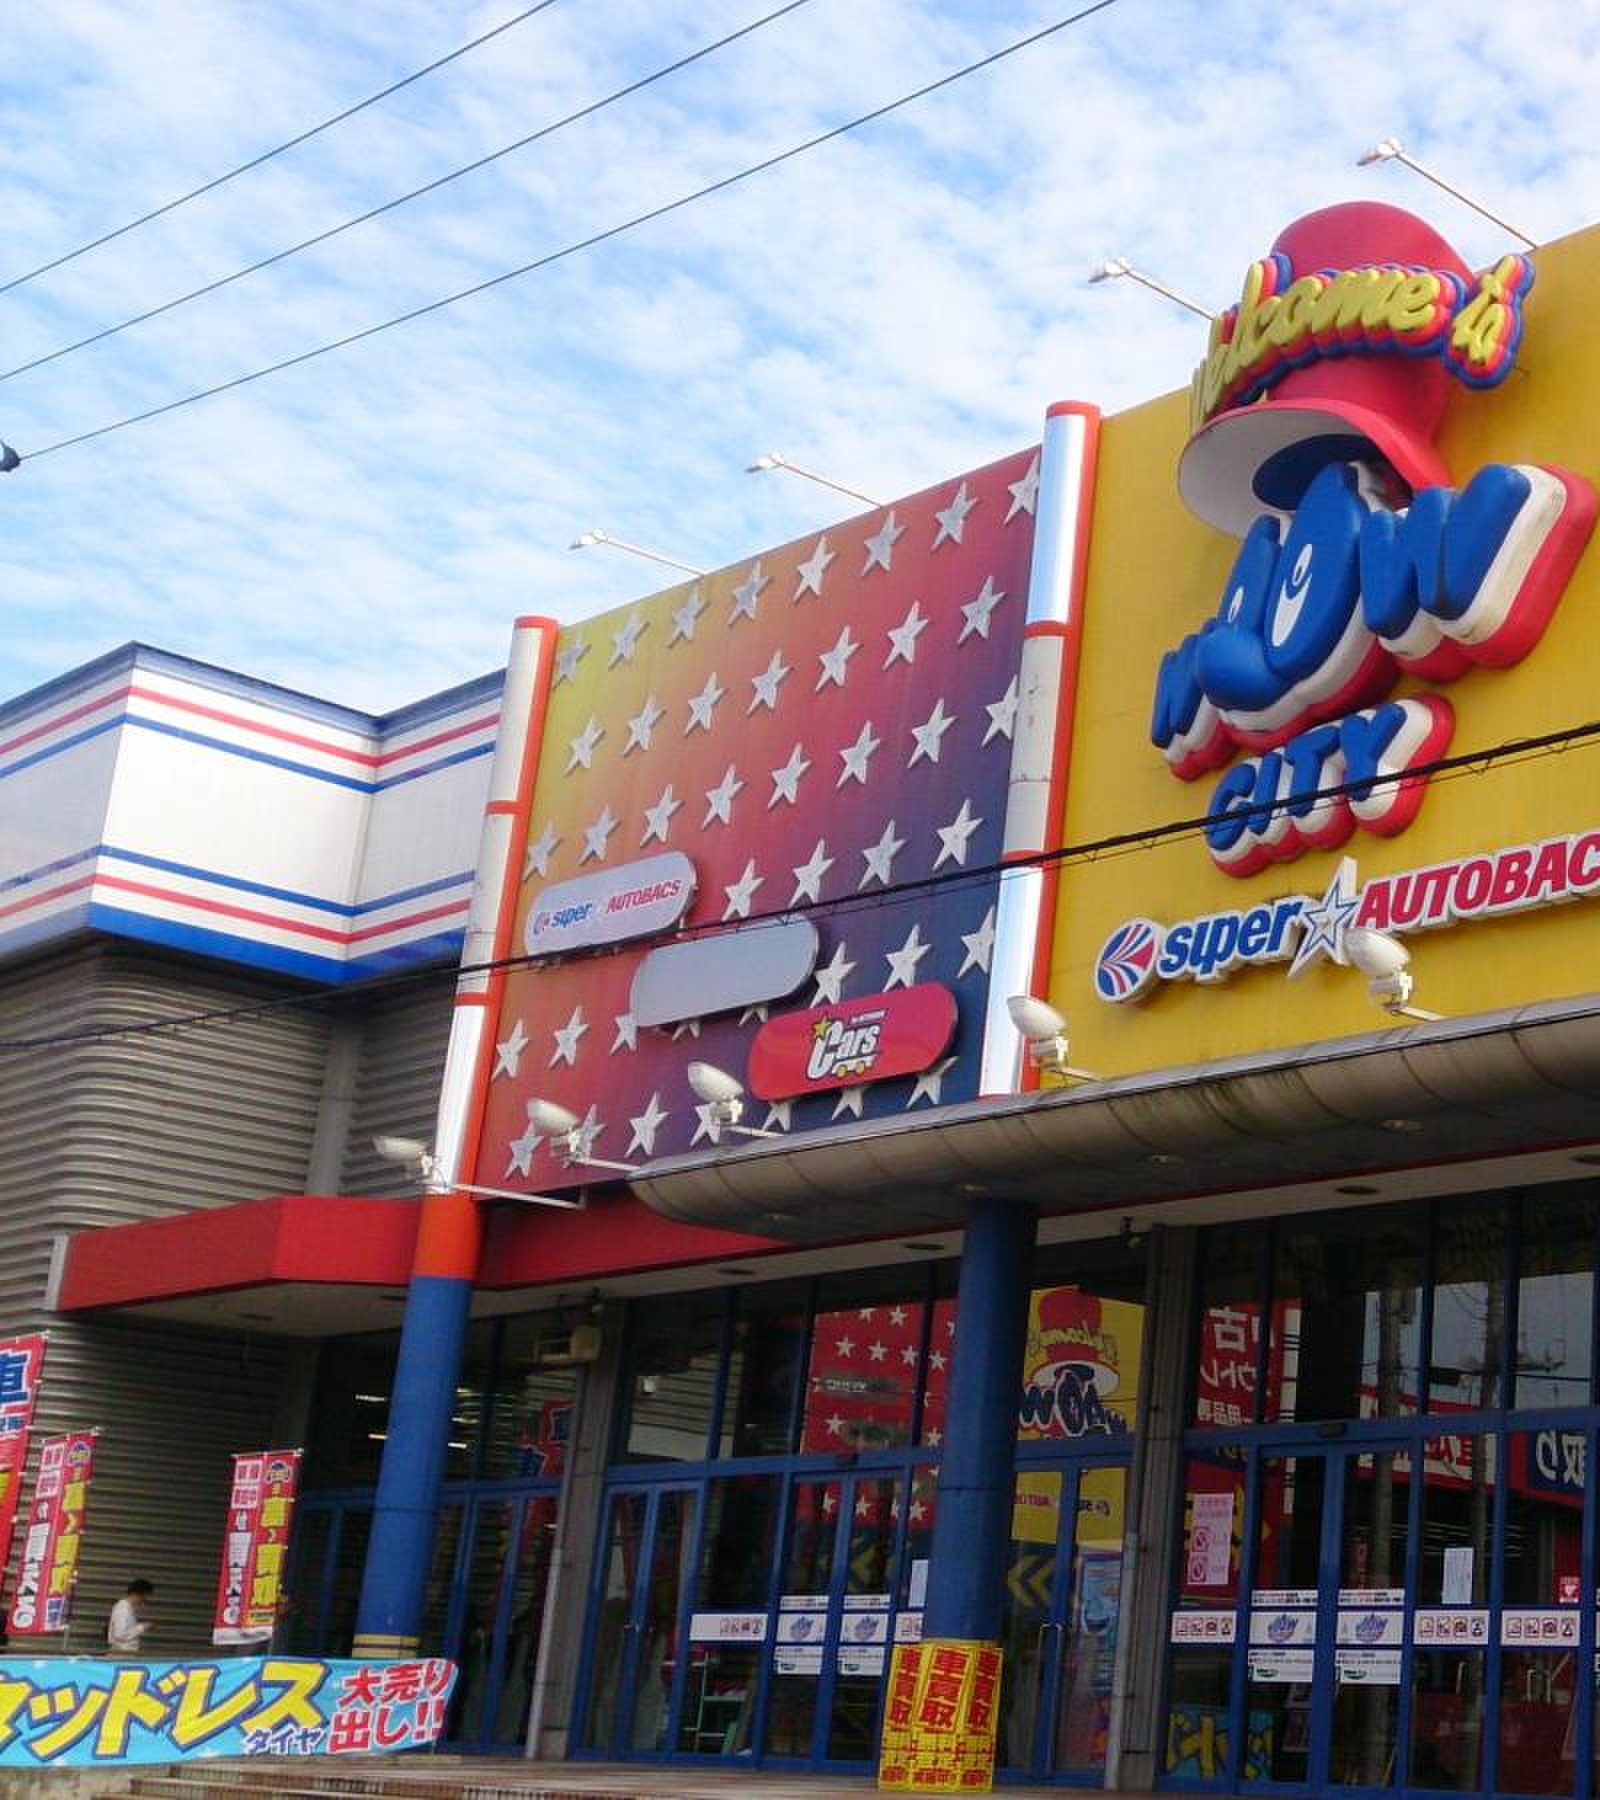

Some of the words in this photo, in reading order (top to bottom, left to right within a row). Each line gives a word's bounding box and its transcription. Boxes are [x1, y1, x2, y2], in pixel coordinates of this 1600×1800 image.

[1205, 702, 1410, 851] CITY
[606, 879, 682, 913] AUTOBACS
[1158, 901, 1304, 979] super
[806, 1020, 881, 1080] Cars
[338, 1659, 455, 1707] 大売り
[245, 1726, 325, 1757] タイヤ
